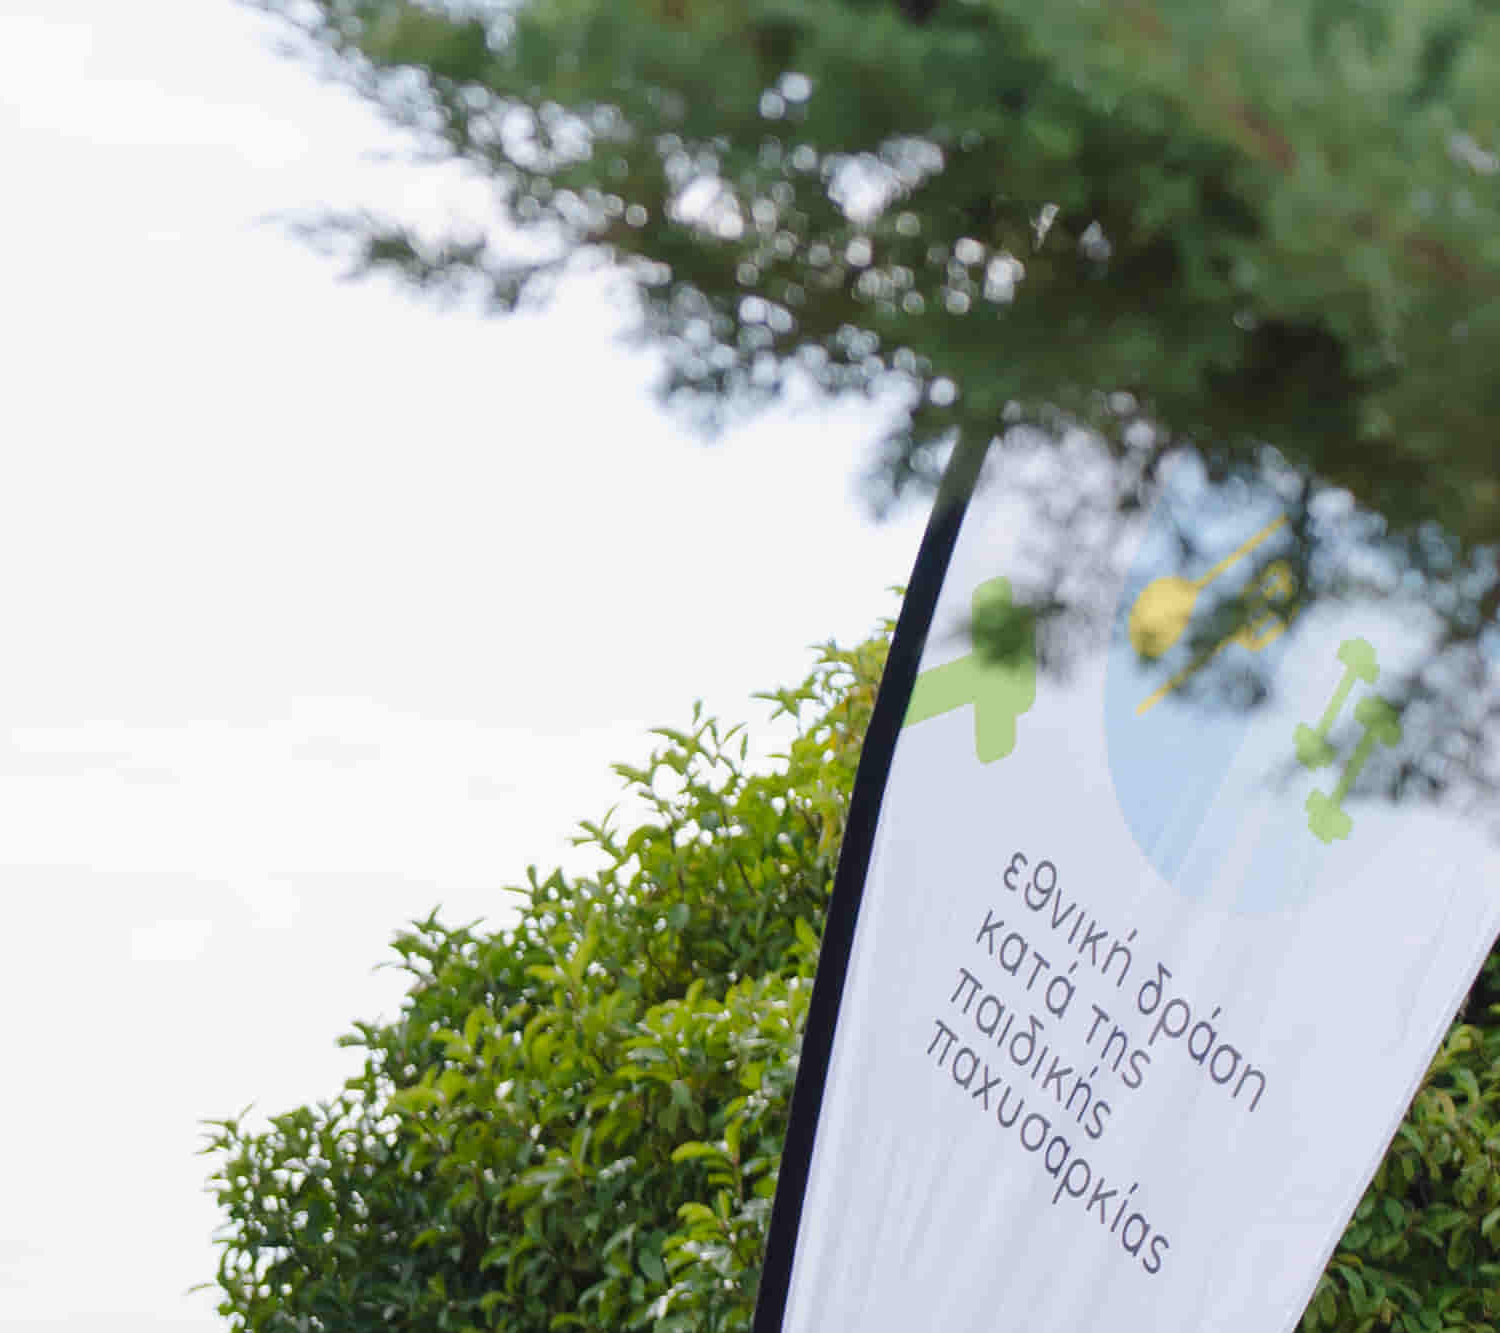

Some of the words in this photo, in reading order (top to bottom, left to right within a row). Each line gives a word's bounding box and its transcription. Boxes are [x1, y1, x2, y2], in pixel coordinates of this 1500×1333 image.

[950, 966, 1113, 1140] παιδικής
[975, 908, 1079, 1019] κατά
[1084, 1003, 1152, 1089] της
[1002, 851, 1138, 988] εθνική
[1136, 961, 1268, 1113] δράση
[925, 1019, 1170, 1275] παχυσαρκίας
